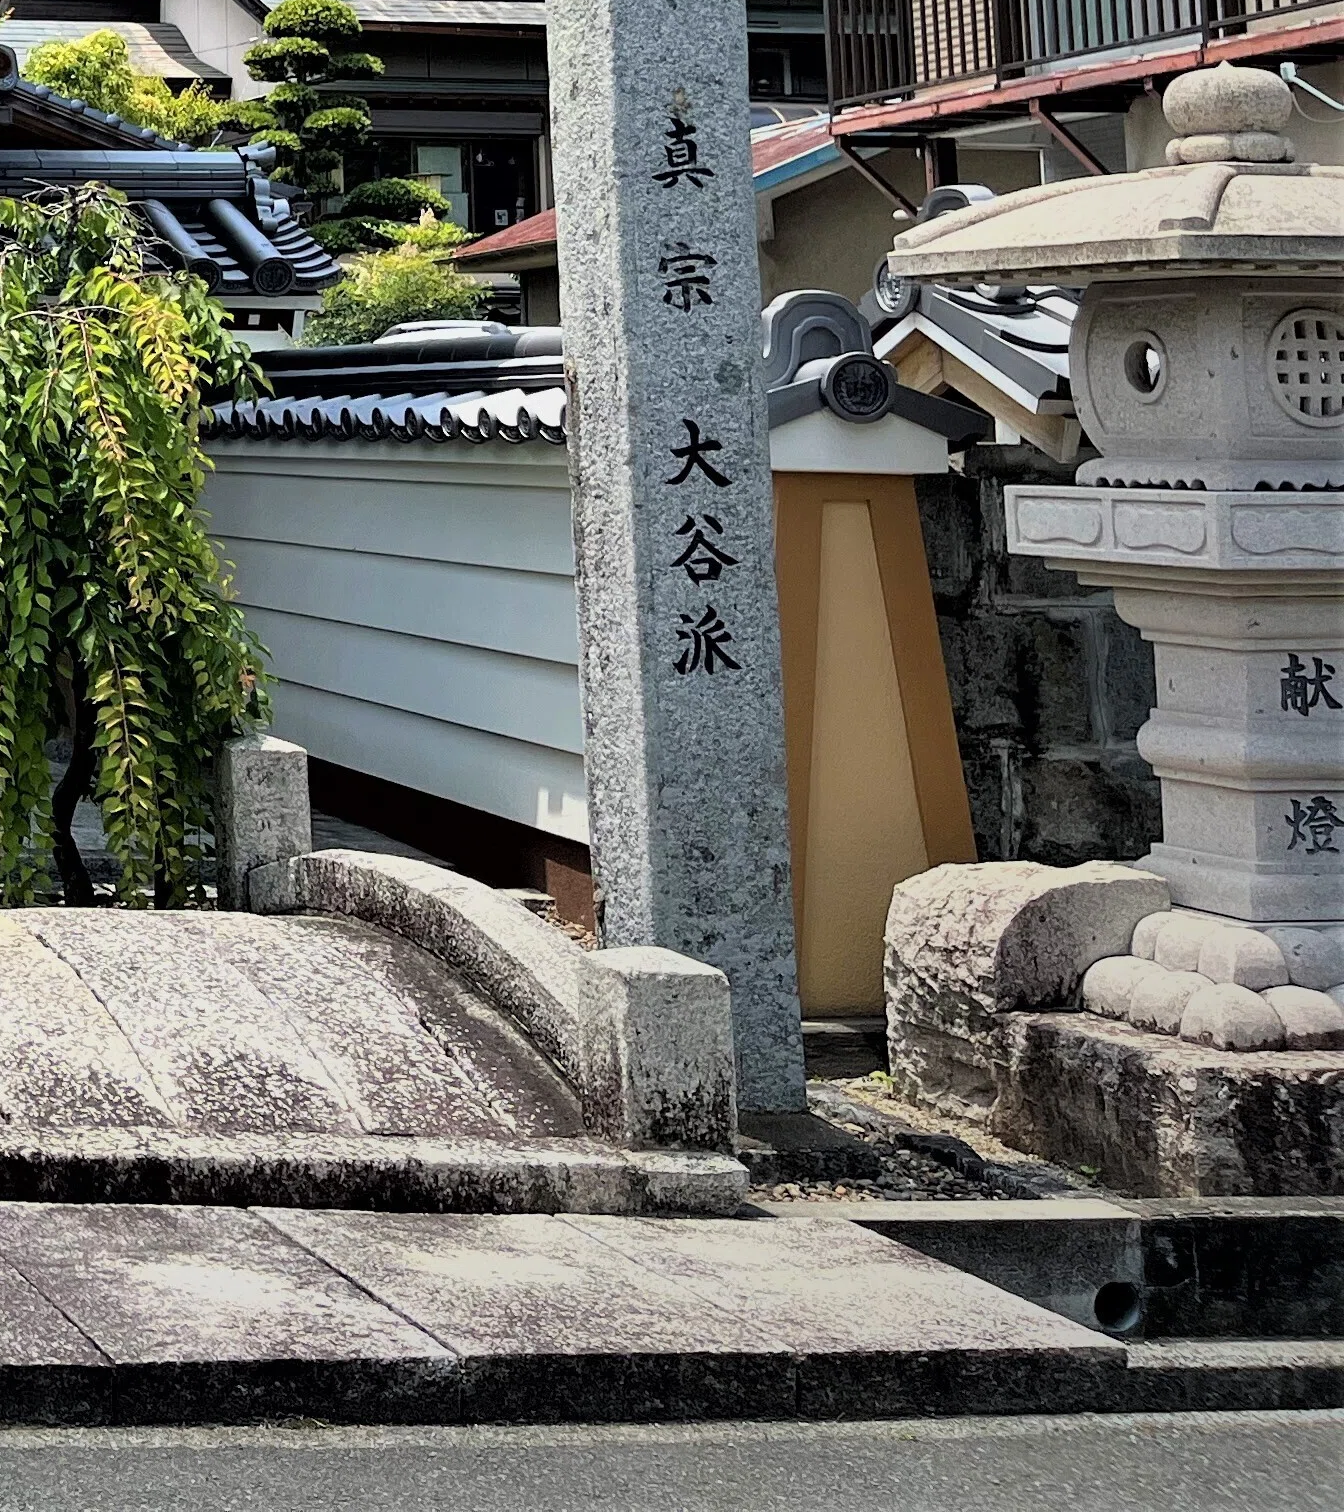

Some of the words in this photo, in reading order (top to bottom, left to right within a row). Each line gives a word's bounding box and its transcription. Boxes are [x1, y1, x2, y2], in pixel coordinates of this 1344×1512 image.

[652, 117, 717, 313] 真宗
[665, 419, 743, 676] 大谷派
